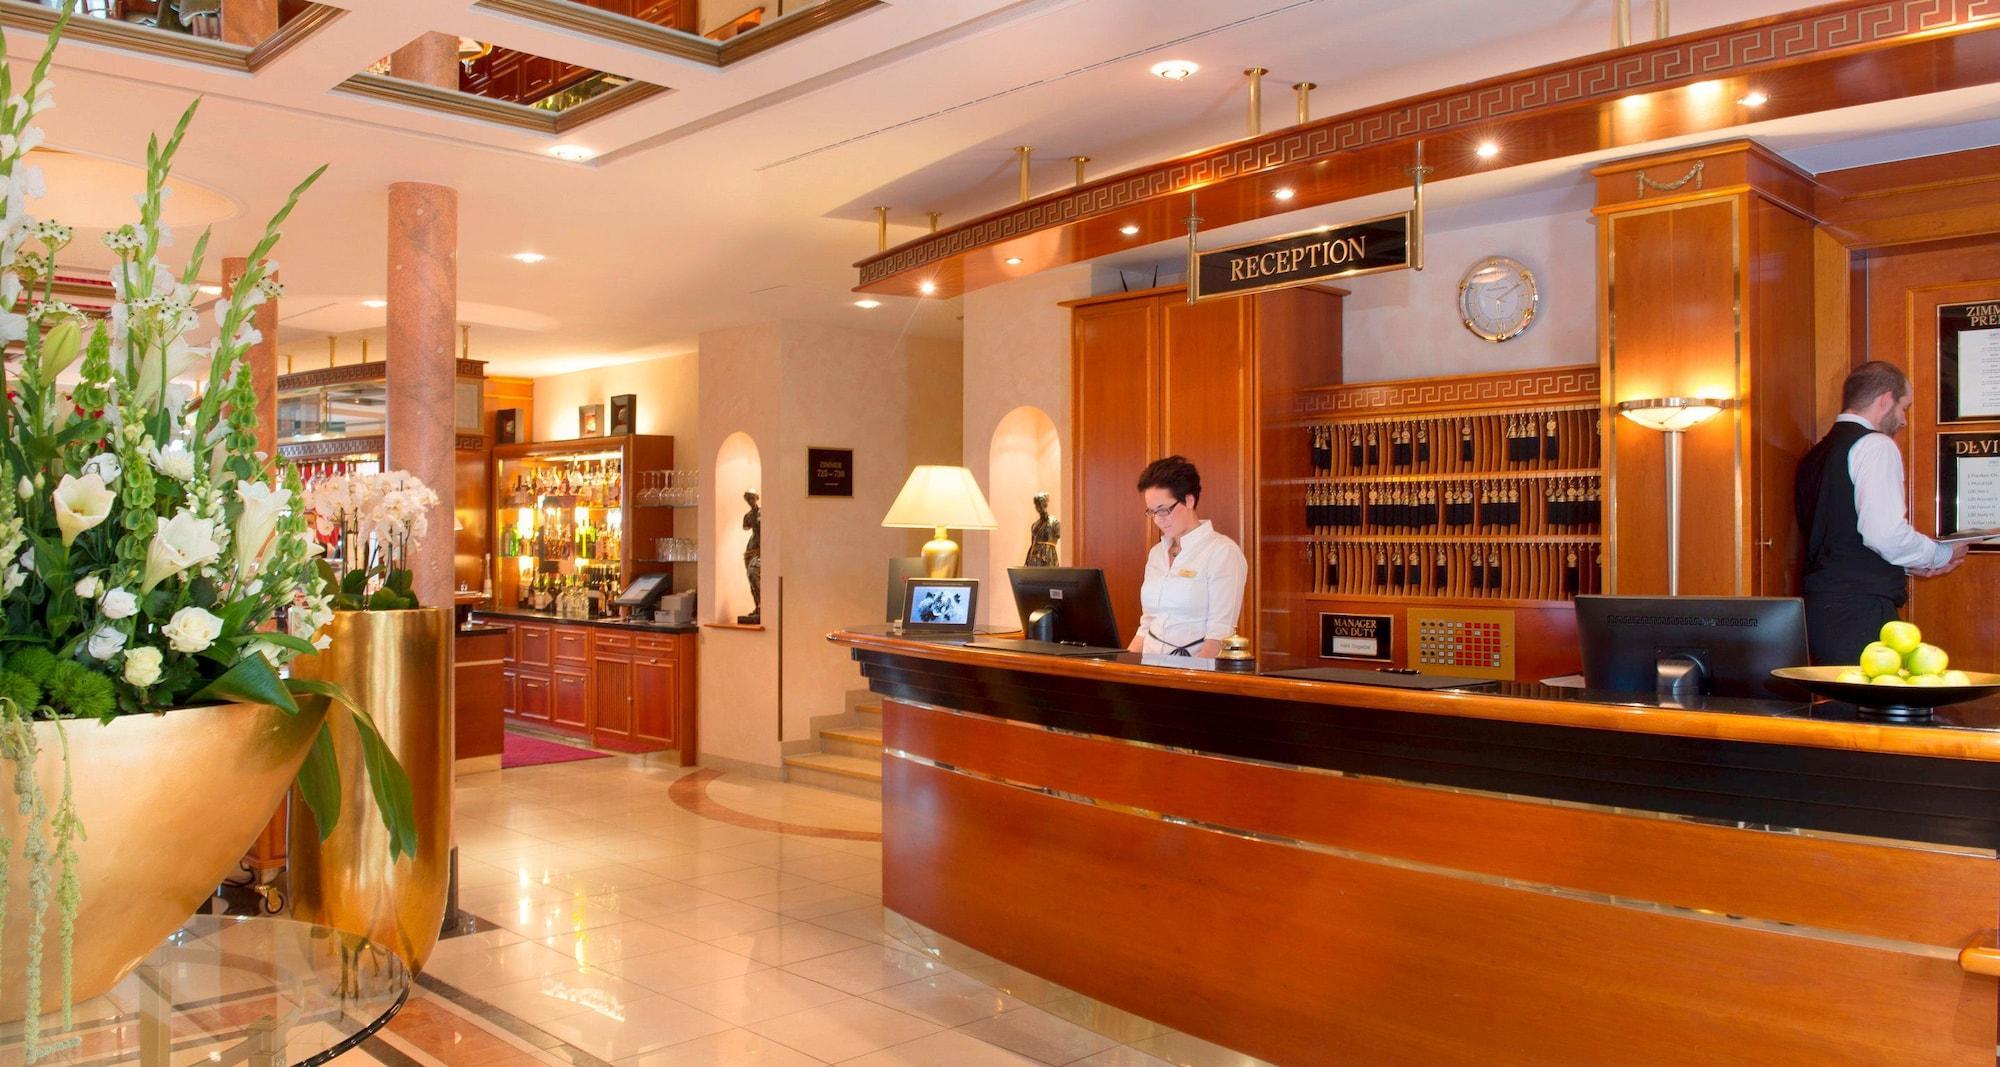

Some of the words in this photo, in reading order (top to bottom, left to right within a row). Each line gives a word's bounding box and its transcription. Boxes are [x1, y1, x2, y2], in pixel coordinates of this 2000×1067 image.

[1230, 236, 1366, 282] RECEPTION
[1333, 618, 1377, 629] MANAGER
[1335, 627, 1349, 635] ON
[1351, 628, 1375, 638] DUTY
